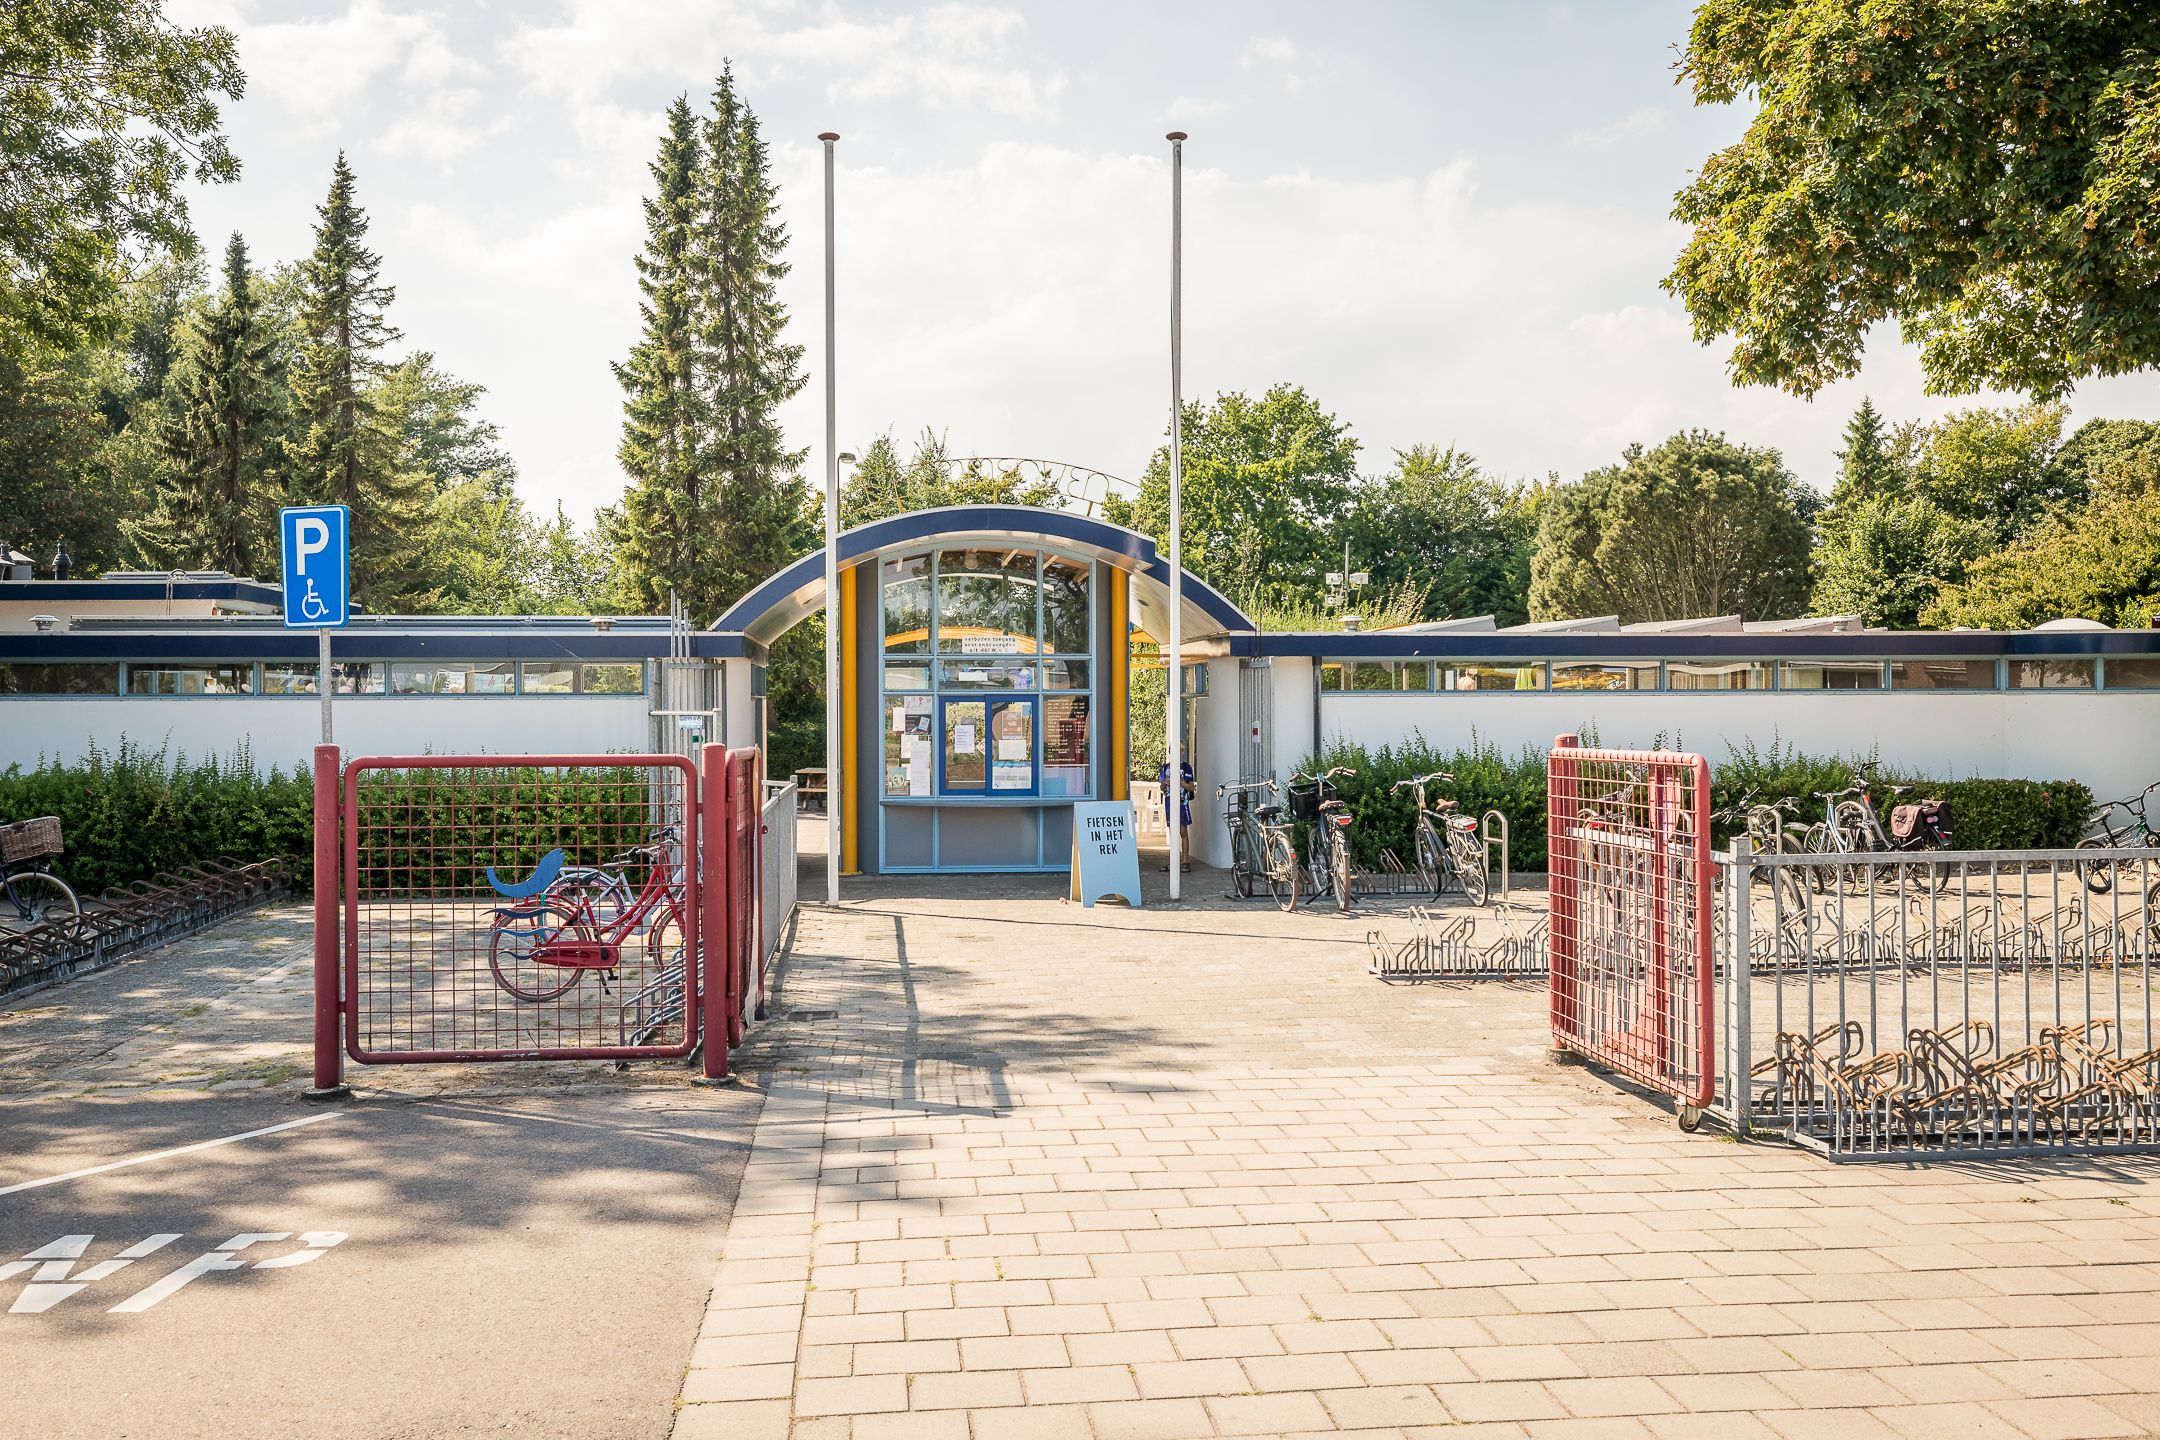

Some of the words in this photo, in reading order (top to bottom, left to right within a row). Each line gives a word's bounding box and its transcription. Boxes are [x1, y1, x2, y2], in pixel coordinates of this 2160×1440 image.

[296, 518, 329, 575] P
[1087, 816, 1124, 828] FIETSEN
[1091, 830, 1101, 841] IN
[1106, 829, 1123, 840] HET
[1100, 844, 1118, 855] REK
